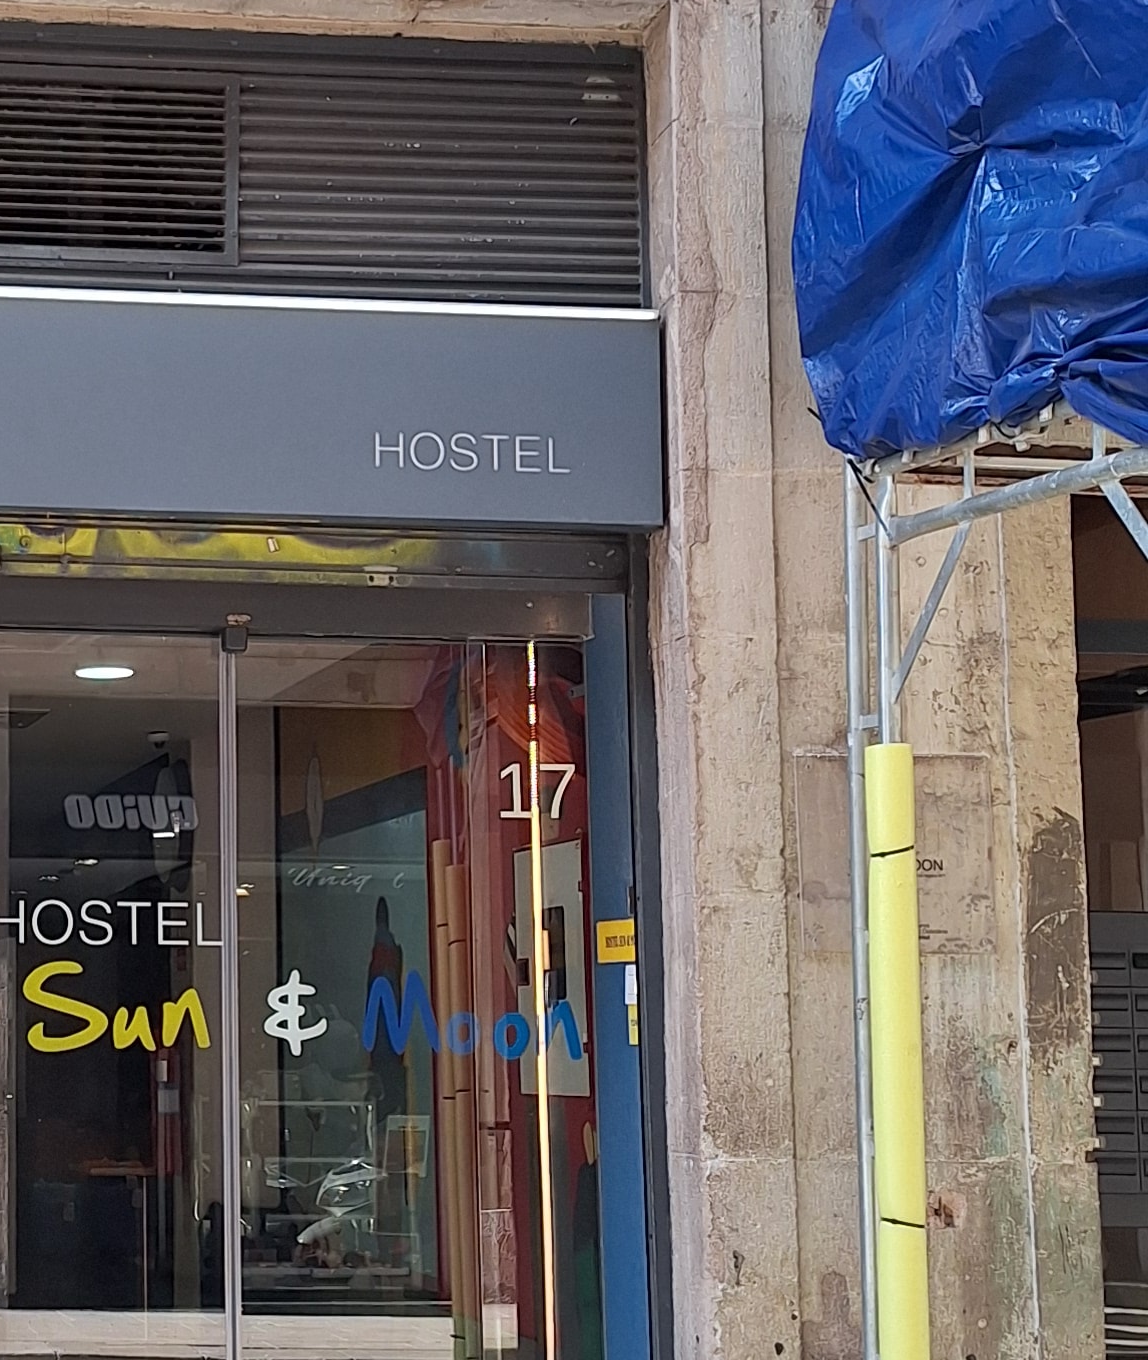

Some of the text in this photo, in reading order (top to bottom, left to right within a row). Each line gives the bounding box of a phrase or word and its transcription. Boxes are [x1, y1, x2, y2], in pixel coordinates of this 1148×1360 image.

[373, 431, 571, 474] HOSTEL
[500, 763, 575, 819] 17
[22, 960, 584, 1061] Sun & Moon
